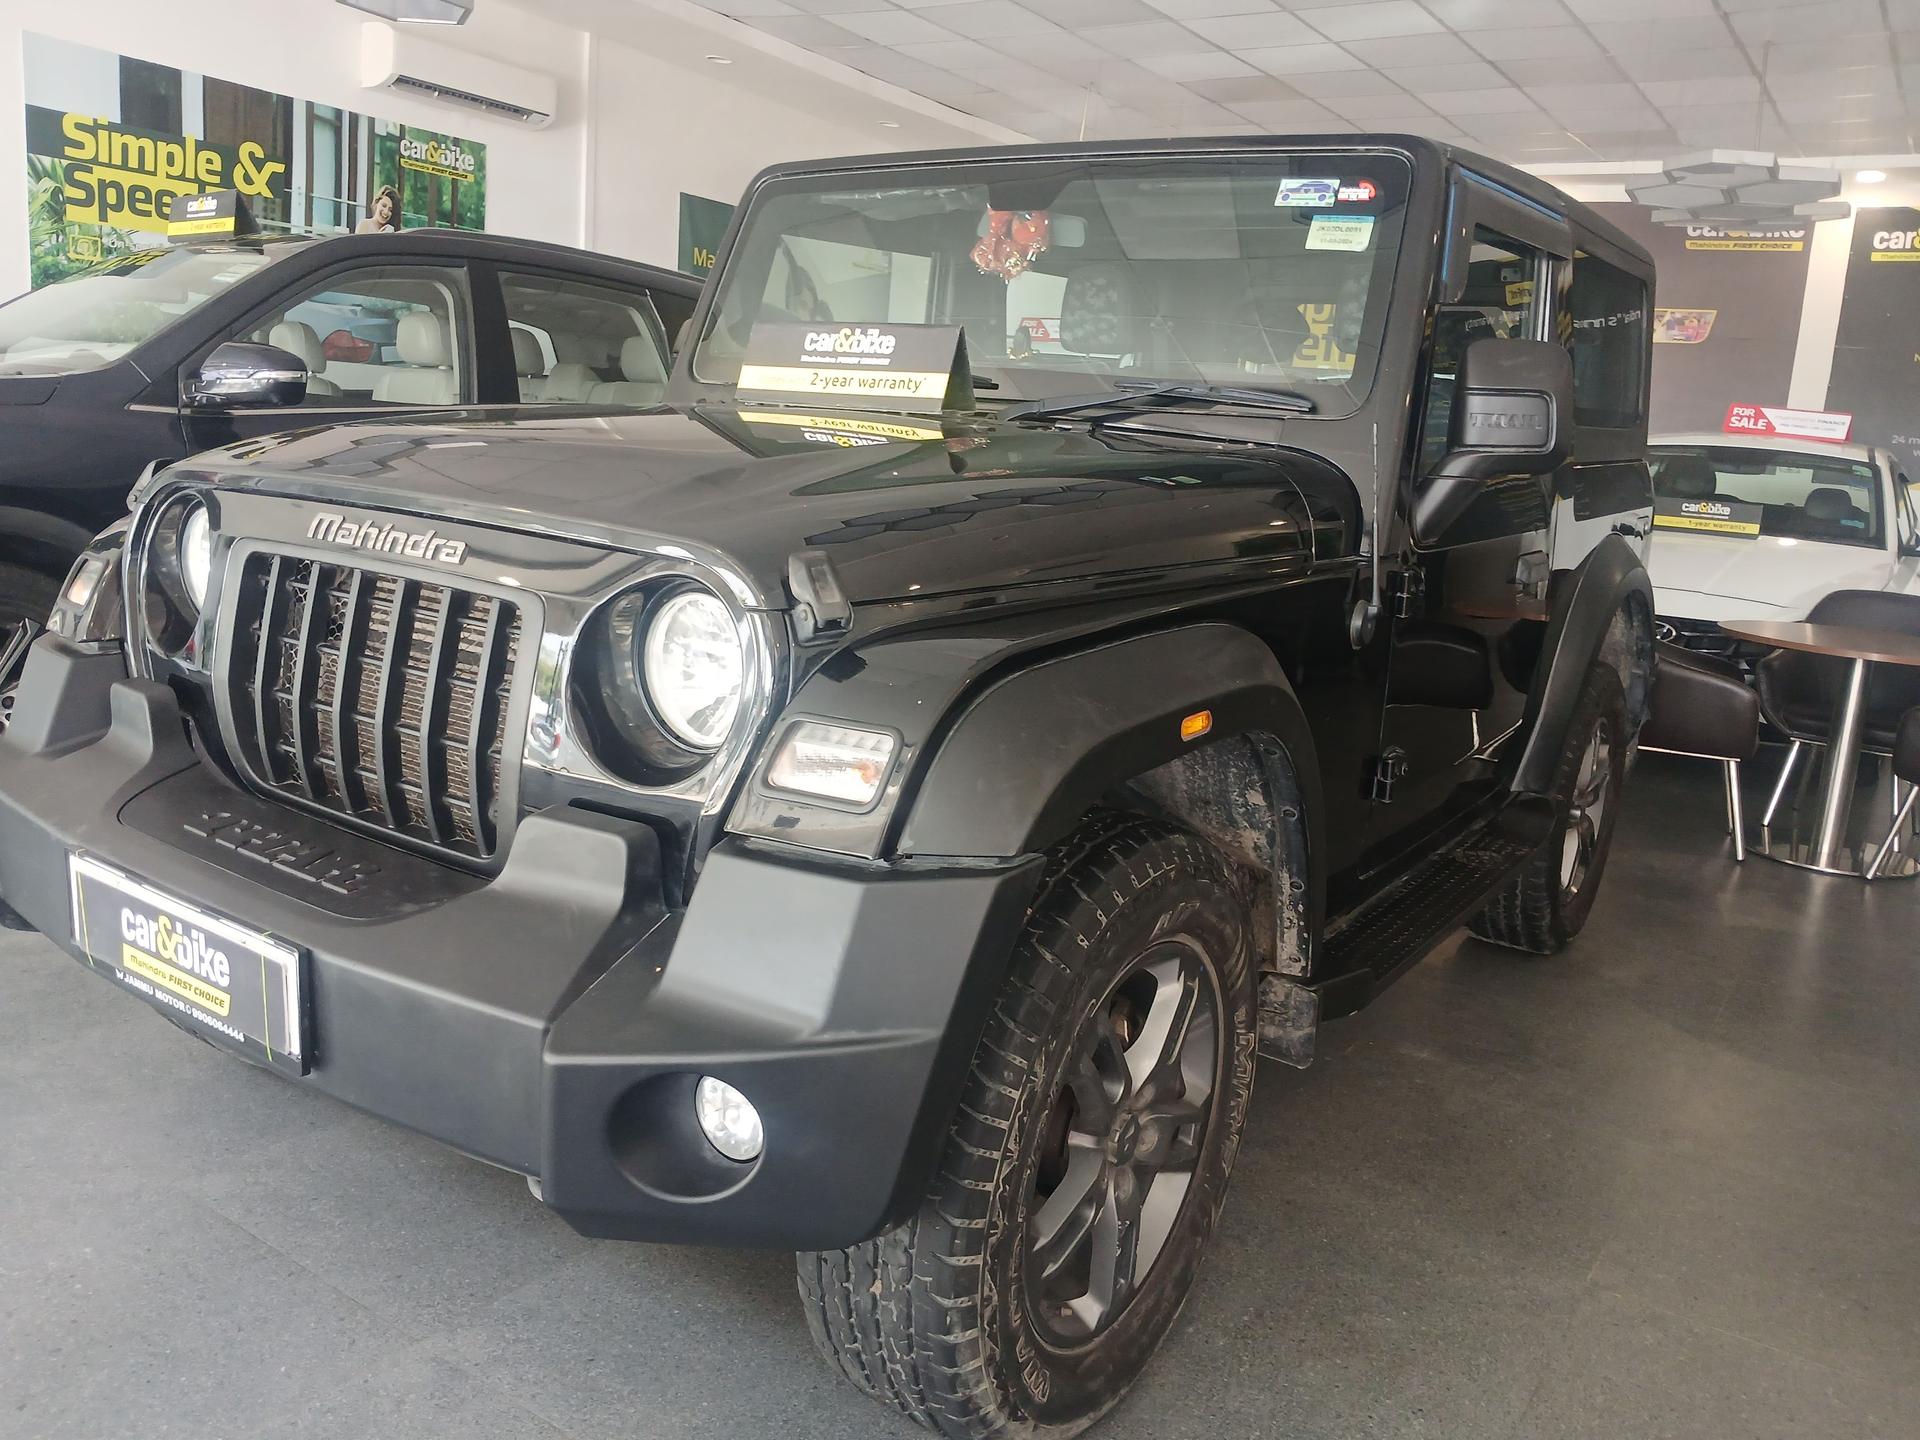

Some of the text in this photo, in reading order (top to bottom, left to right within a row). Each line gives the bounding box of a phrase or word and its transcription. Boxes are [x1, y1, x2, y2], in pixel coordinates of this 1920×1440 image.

[62, 112, 286, 199] Simple &
[400, 139, 475, 171] car&bike
[64, 162, 206, 222] Spee
[693, 247, 717, 269] Ma
[803, 328, 896, 355] car&bike
[810, 372, 854, 389] 2-year
[1729, 416, 1768, 430] SALE
[1733, 407, 1755, 416] FOR
[1681, 501, 1731, 515] car&bike
[306, 512, 469, 565] Mahindra
[1713, 522, 1746, 531] warranty
[121, 908, 231, 988] car&bike
[168, 974, 193, 991] FIRST
[194, 986, 225, 1008] CHOICE
